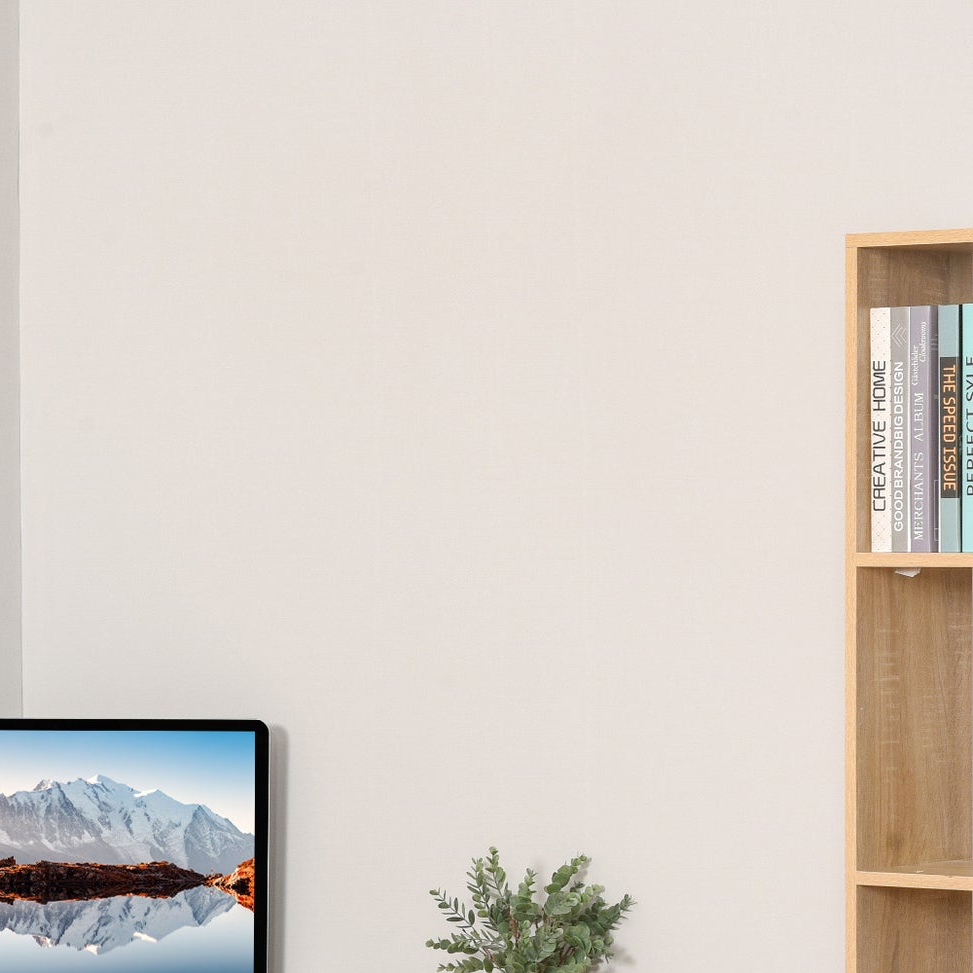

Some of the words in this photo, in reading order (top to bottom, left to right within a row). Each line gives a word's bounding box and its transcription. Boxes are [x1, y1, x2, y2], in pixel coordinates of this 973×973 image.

[873, 360, 886, 412] HOME
[943, 364, 956, 393] THE
[914, 392, 924, 442] ALBUM
[943, 397, 956, 443] SPEED
[873, 421, 886, 512] CREATIVE
[943, 446, 957, 491] ISSUE
[914, 452, 924, 540] MERCHANTS
